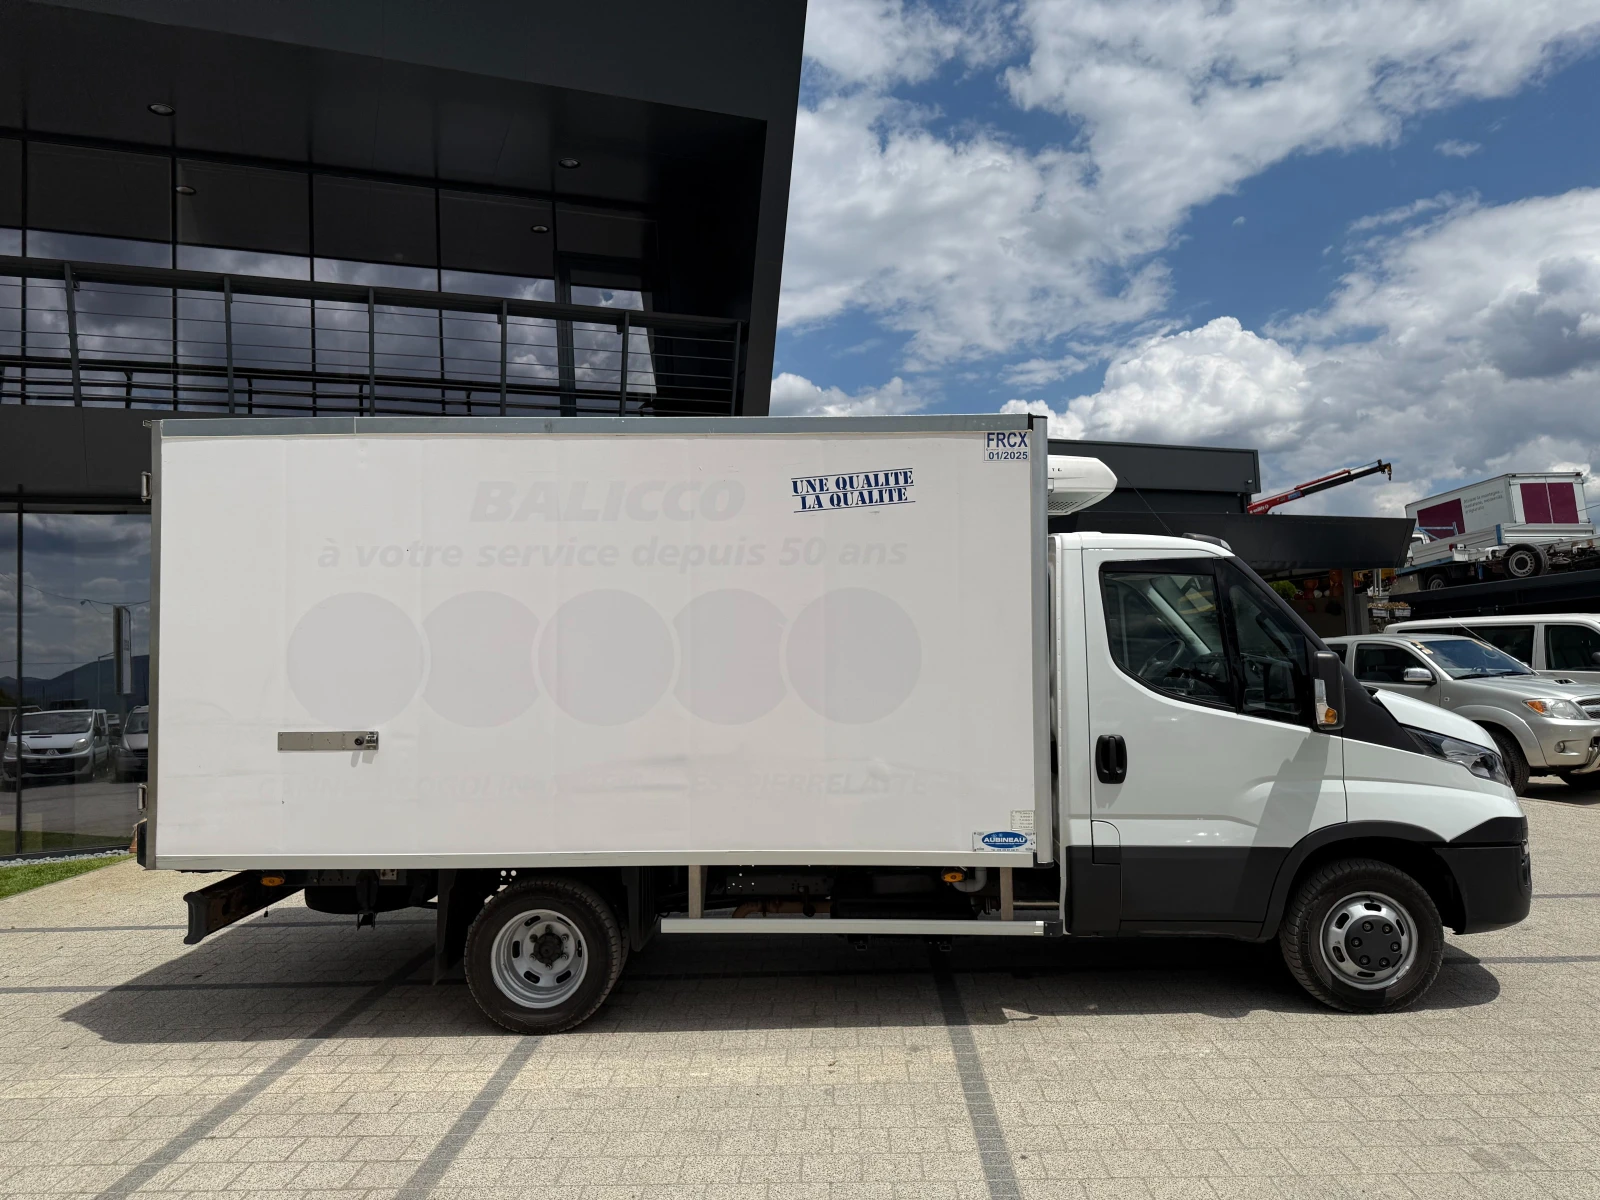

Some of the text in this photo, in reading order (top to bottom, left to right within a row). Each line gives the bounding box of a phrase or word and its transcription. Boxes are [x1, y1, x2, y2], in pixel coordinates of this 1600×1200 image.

[986, 432, 1028, 448] FRCX
[988, 451, 1028, 460] 01/2025
[791, 470, 914, 495] UNE QUALITE
[469, 480, 747, 523] BALICCO
[800, 487, 908, 510] LA QUALITE
